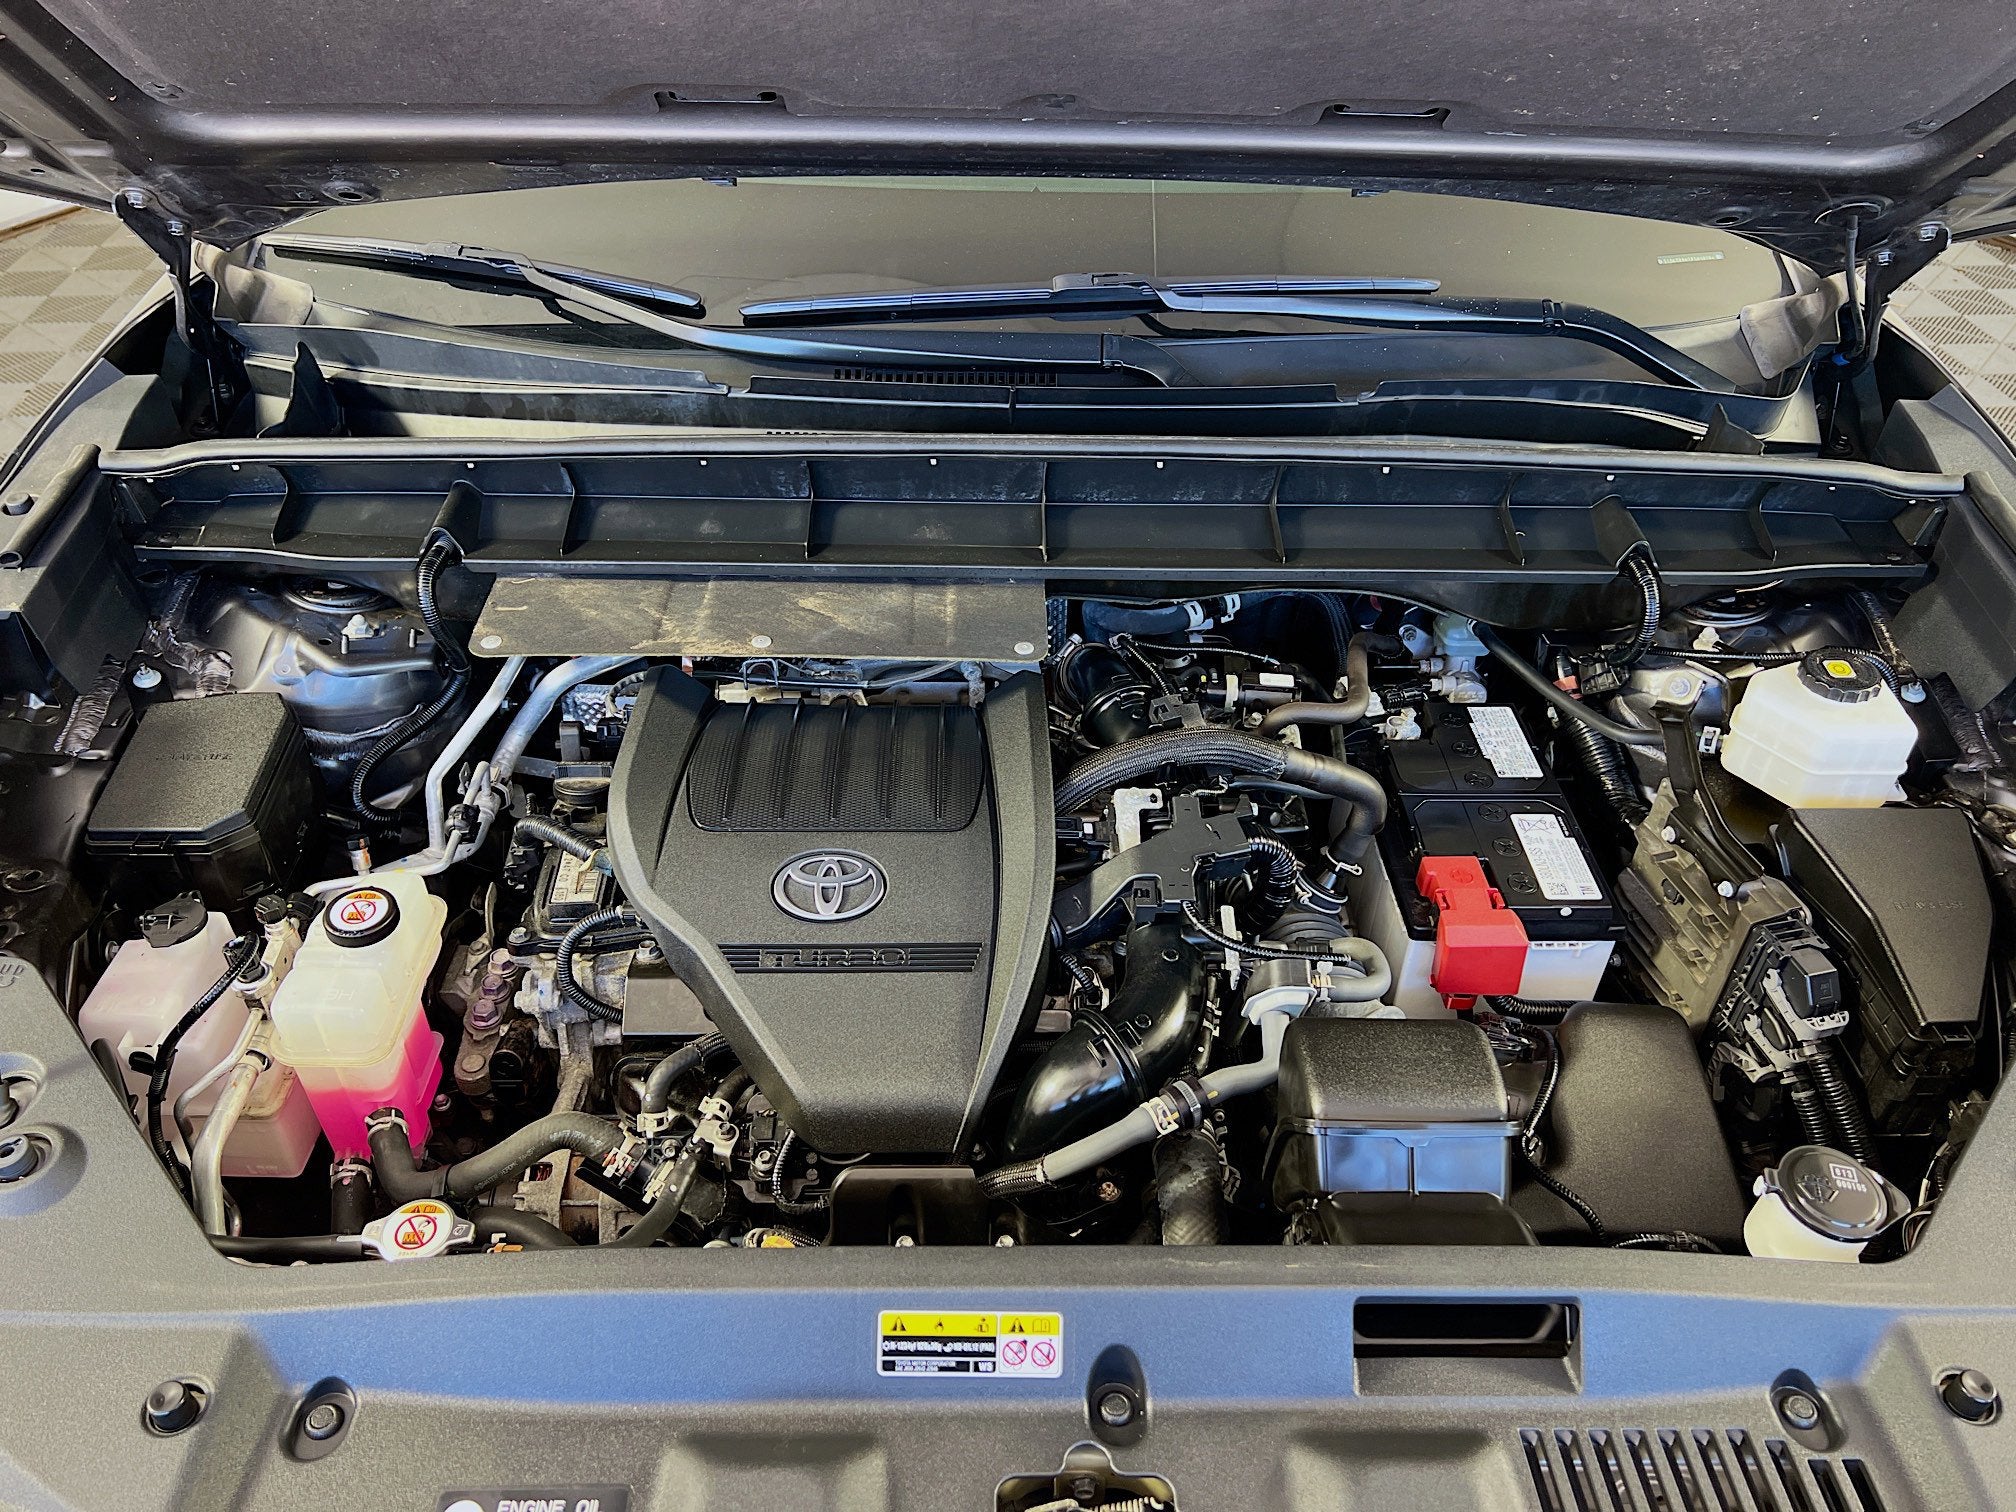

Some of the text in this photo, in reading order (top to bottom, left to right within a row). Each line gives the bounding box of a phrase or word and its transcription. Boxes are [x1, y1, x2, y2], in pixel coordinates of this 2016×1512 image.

[759, 948, 911, 968] TURBO
[978, 1361, 993, 1372] WS
[497, 1499, 601, 1512] ENGINE OIL
